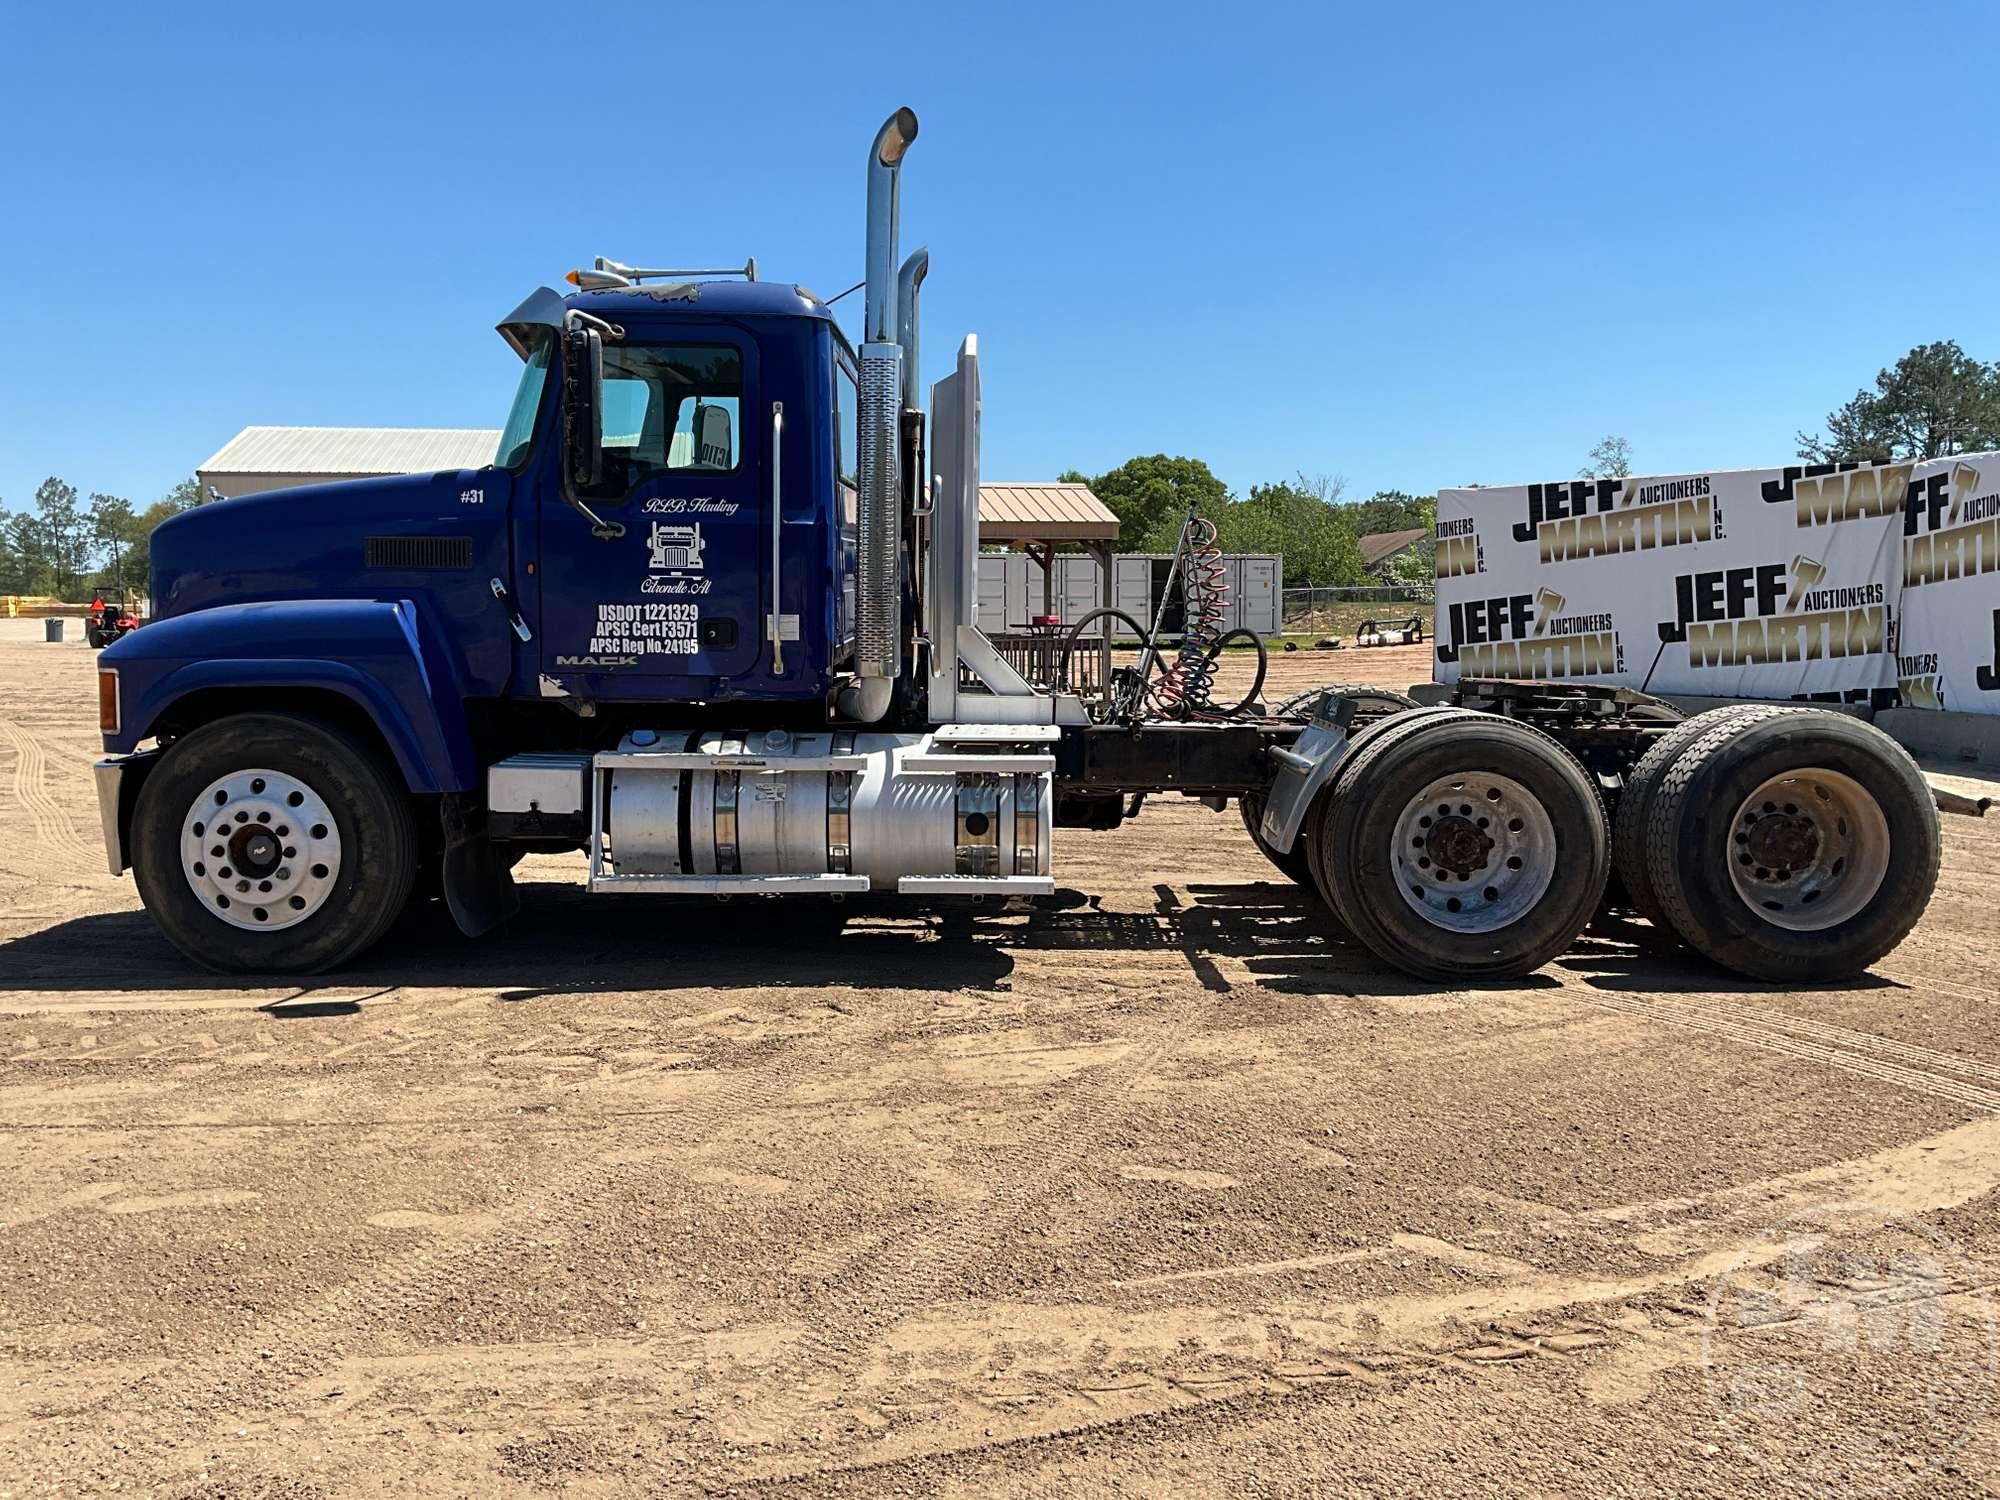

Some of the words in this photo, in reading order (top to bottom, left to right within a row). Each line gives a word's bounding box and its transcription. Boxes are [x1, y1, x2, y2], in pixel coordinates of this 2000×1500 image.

[460, 489, 484, 504] #31
[1640, 476, 1710, 505] AUCTIONEERS
[687, 497, 739, 516] Hauling
[1512, 479, 1622, 543] JEFF
[1540, 497, 1711, 564] MARTIN
[1903, 518, 2000, 588] ARTI
[598, 604, 642, 621] USDOT
[645, 603, 699, 620] 1221329
[1657, 564, 1786, 643] JEFF
[596, 621, 629, 636] APSC
[632, 621, 661, 637] Cert
[662, 621, 697, 638] F3571
[1437, 594, 1534, 664] JEFF
[1550, 613, 1612, 636] AUCTIONEERS
[1689, 606, 1883, 669] MARTIN
[556, 656, 638, 665] MACK
[589, 638, 620, 653] APSC
[622, 639, 645, 655] Reg
[646, 640, 664, 653] No.
[664, 639, 699, 654] 24195
[1461, 632, 1614, 679] MARTIN
